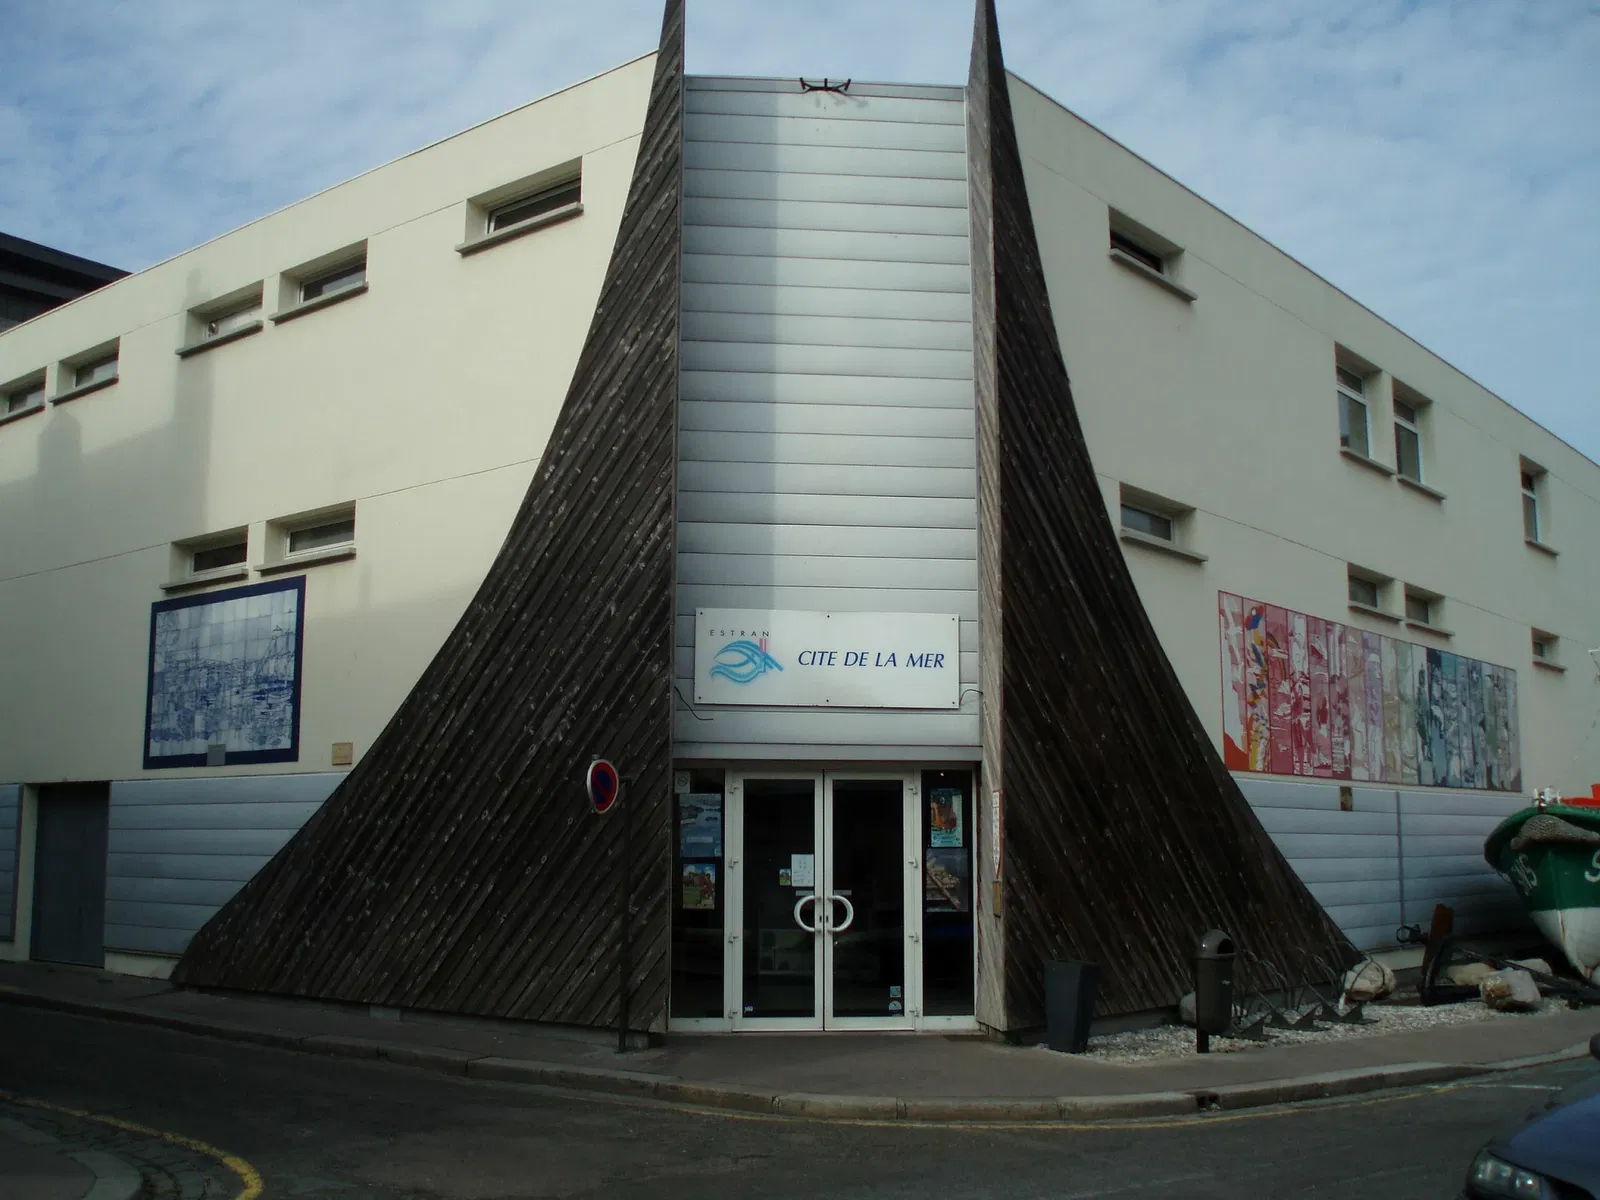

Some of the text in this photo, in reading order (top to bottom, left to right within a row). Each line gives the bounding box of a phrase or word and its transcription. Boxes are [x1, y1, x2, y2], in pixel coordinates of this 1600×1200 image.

[709, 629, 770, 637] ESTRAN
[798, 650, 945, 669] CITE DE LA MER
